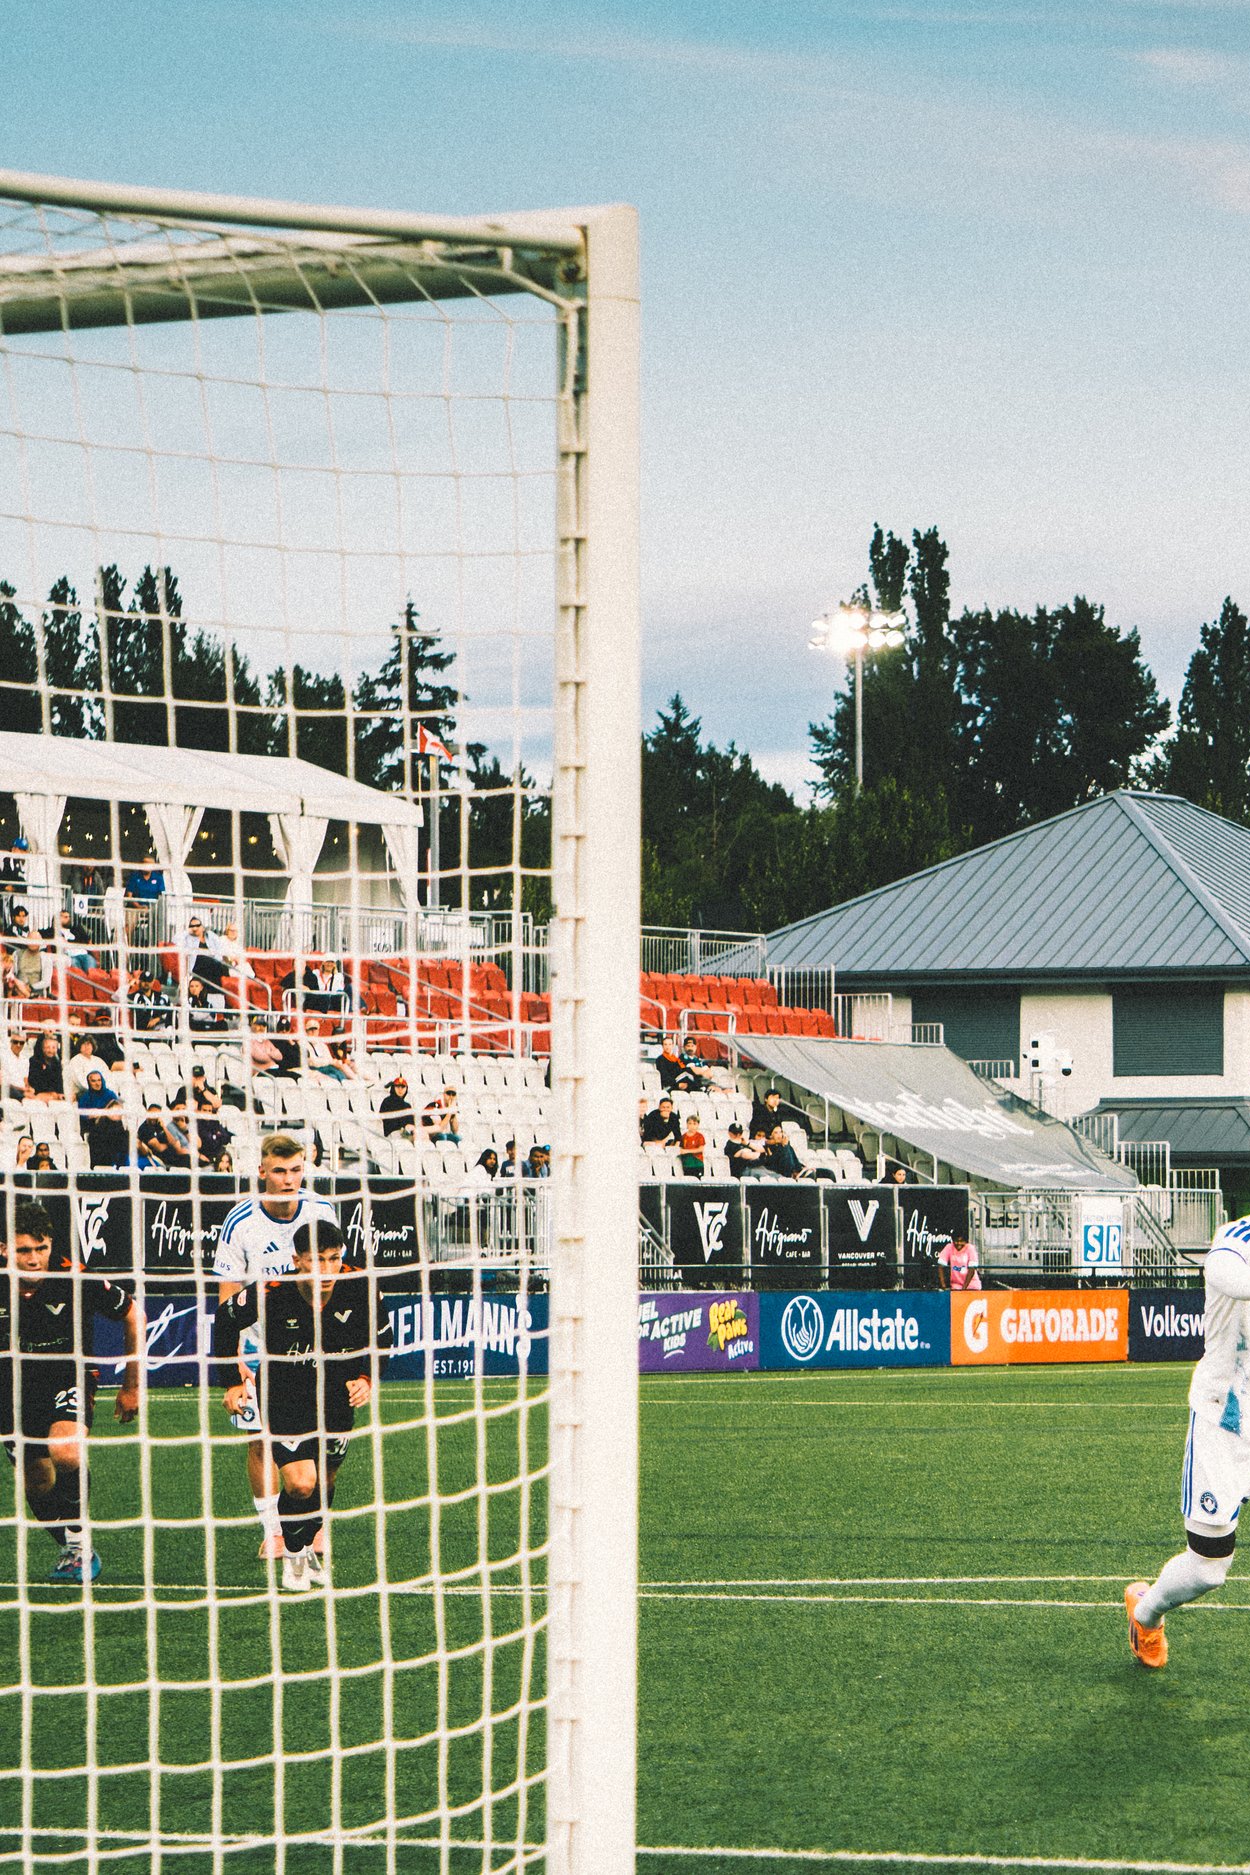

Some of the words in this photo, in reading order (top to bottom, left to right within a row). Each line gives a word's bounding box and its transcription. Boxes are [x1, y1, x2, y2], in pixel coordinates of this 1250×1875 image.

[755, 1207, 812, 1258] Artigiano
[837, 1252, 875, 1260] VANCOUVER
[650, 1307, 703, 1341] ACTIVE
[825, 1308, 919, 1352] Allstate
[1000, 1308, 1119, 1344] GATORADE
[663, 1332, 687, 1353] KIDS
[727, 1338, 754, 1360] Active
